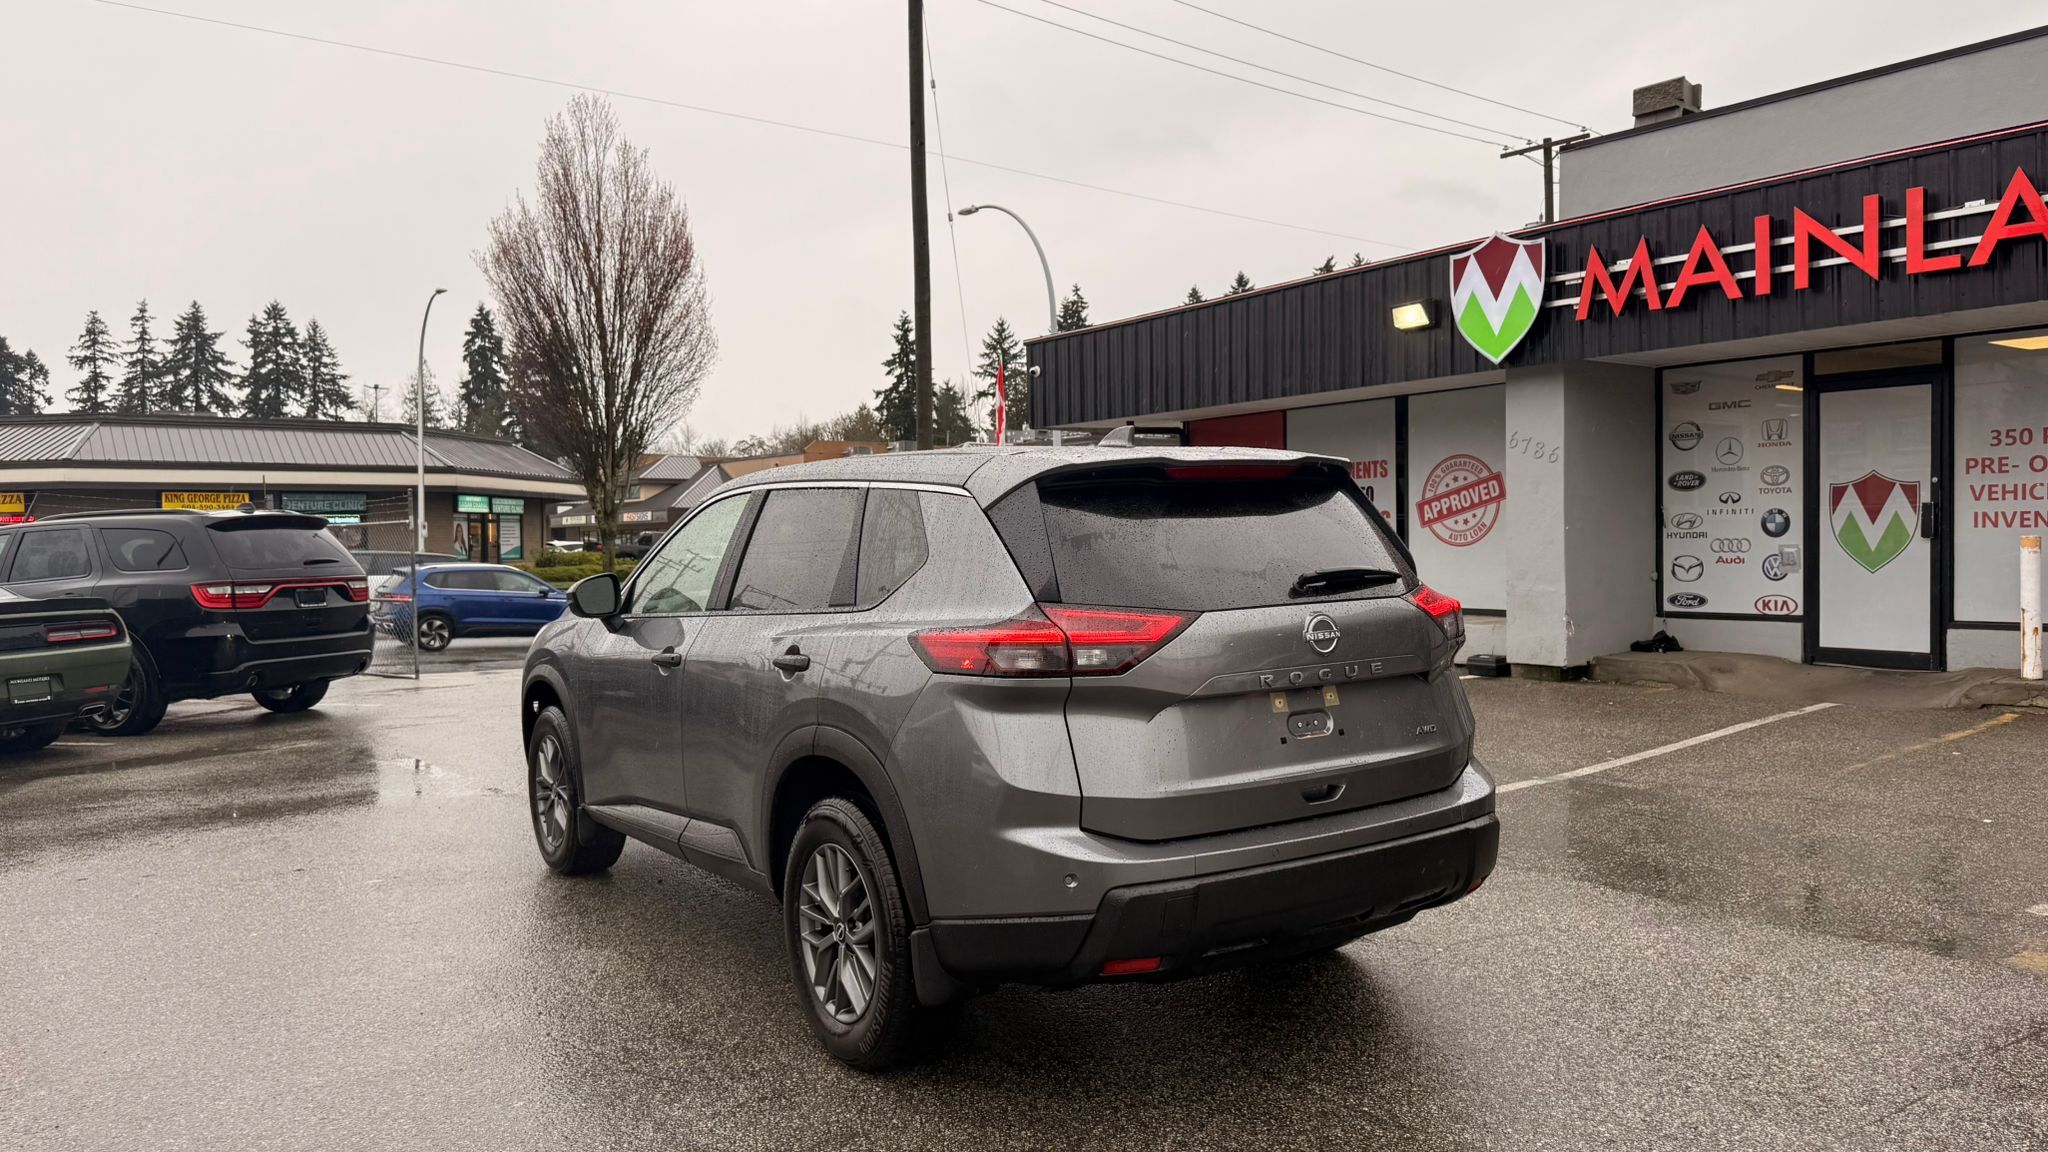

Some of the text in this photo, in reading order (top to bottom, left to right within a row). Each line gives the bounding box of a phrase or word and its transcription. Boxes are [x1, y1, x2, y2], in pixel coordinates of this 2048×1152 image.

[1708, 399, 1752, 411] GMC
[1671, 432, 1701, 440] NISSAN
[1990, 427, 2034, 447] 350
[1508, 431, 1560, 464] 6786
[1757, 440, 1793, 448] HONDA
[1440, 460, 1484, 475] GUARANTEED
[1758, 487, 1793, 495] TOYOTA
[1969, 483, 2048, 501] VEHIC
[165, 493, 247, 504] KING GEORGE PIZZA
[1423, 480, 1500, 522] APPROVED
[331, 501, 365, 511] CLINIC
[1448, 521, 1488, 543] AUTO LOAN
[1666, 531, 1708, 540] HYUNDAI
[1715, 555, 1745, 565] Audi
[1674, 594, 1701, 607] Ford
[1762, 599, 1791, 612] KIA
[1306, 630, 1341, 641] NISSAN
[1259, 662, 1384, 689] ROGUE
[1416, 724, 1437, 736] AWD
